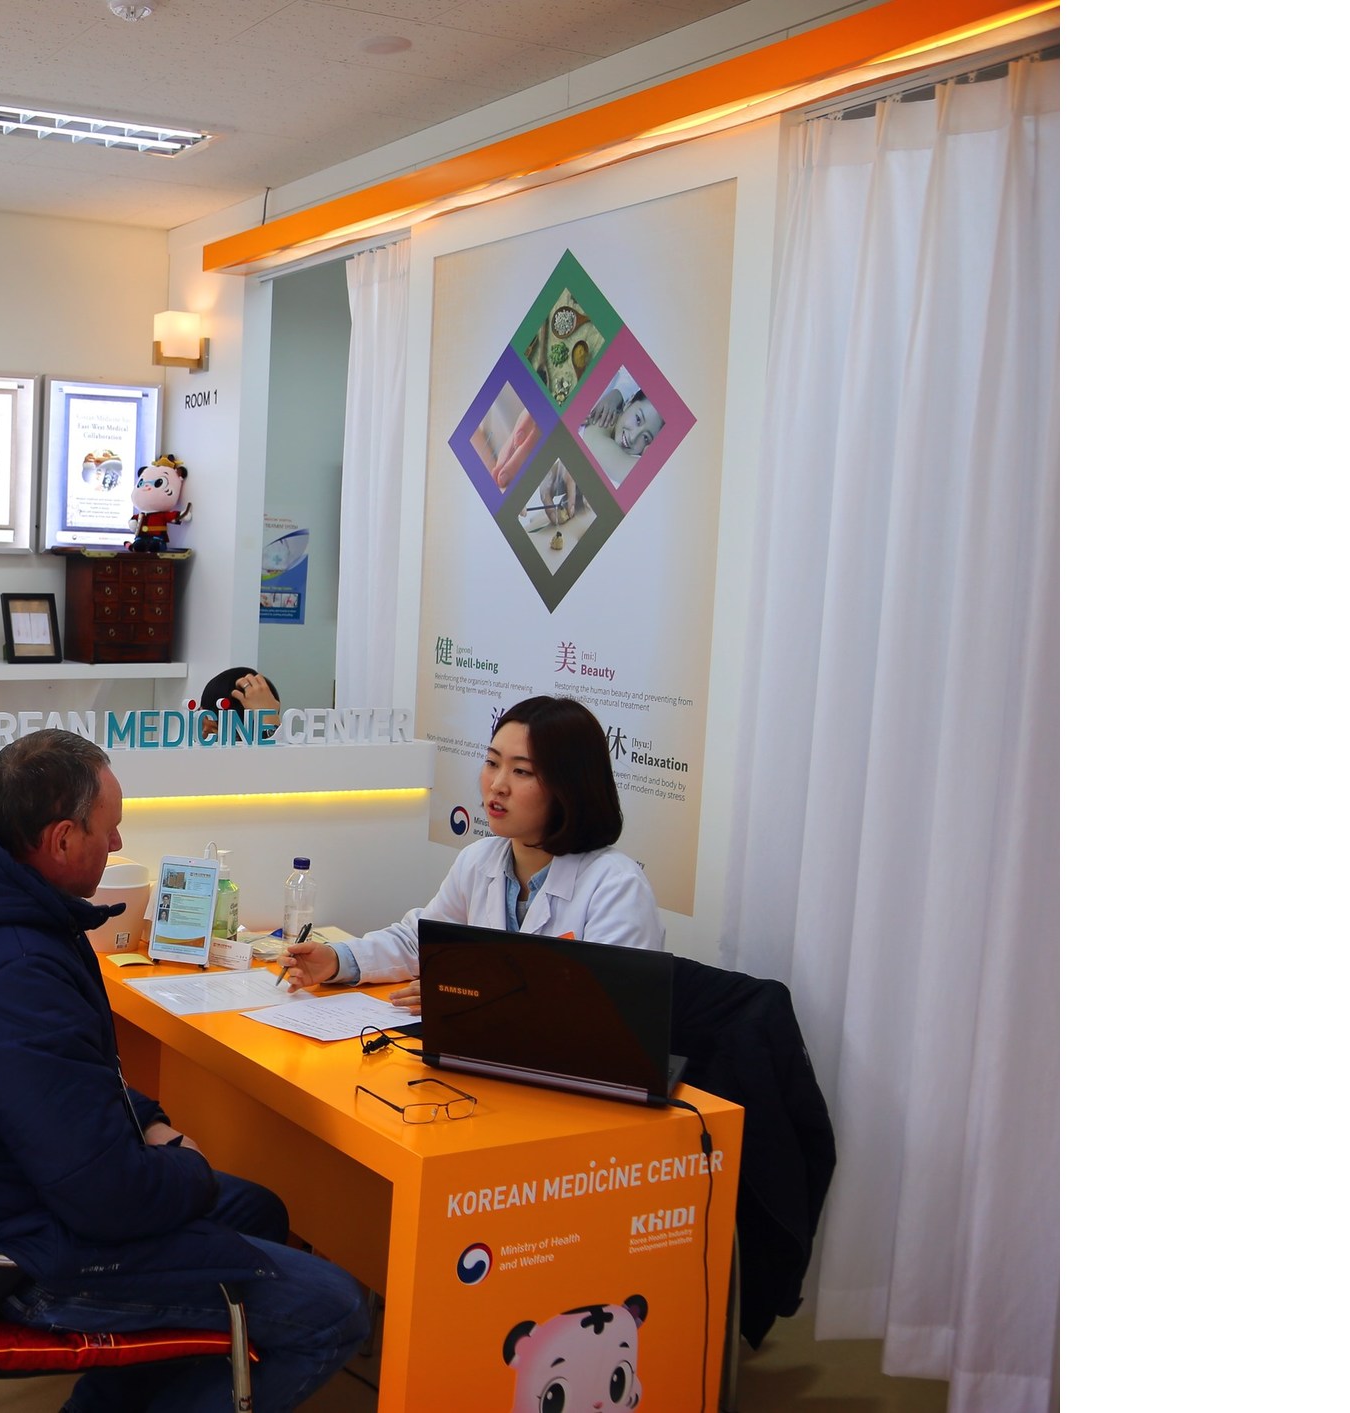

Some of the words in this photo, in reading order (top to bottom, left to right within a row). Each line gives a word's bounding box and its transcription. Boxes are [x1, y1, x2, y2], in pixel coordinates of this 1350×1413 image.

[185, 391, 210, 409] ROOM
[214, 389, 217, 404] 1
[436, 637, 453, 665] 健
[555, 641, 576, 674] 美
[456, 657, 498, 674] Well-being
[581, 664, 615, 681] Beauty
[435, 673, 459, 683] Reinforcing
[510, 683, 533, 694] renewing
[555, 682, 579, 693] Restoring
[580, 685, 589, 693] the
[590, 687, 610, 696] human
[611, 689, 631, 699] beauty
[632, 692, 643, 700] and
[644, 694, 677, 706] preventing
[678, 697, 693, 706] from
[600, 698, 619, 708] natural
[620, 701, 649, 712] treatment
[282, 708, 414, 744] CENTER
[606, 726, 627, 759] 休
[631, 752, 688, 772] Relaxation
[631, 785, 654, 794] modern
[655, 789, 666, 799] day
[668, 792, 685, 801] stress
[632, 774, 647, 783] mind
[648, 777, 660, 785] and
[661, 779, 677, 790] body
[678, 781, 686, 792] by
[474, 817, 490, 827] Minist
[438, 984, 479, 997] SAMSUNG
[447, 1181, 537, 1218] KOREAN
[647, 1150, 724, 1183] CENTER
[500, 1242, 537, 1256] Ministry
[539, 1238, 549, 1249] of
[551, 1233, 580, 1247] Health
[499, 1259, 517, 1271] and
[520, 1253, 554, 1267] Welfare
